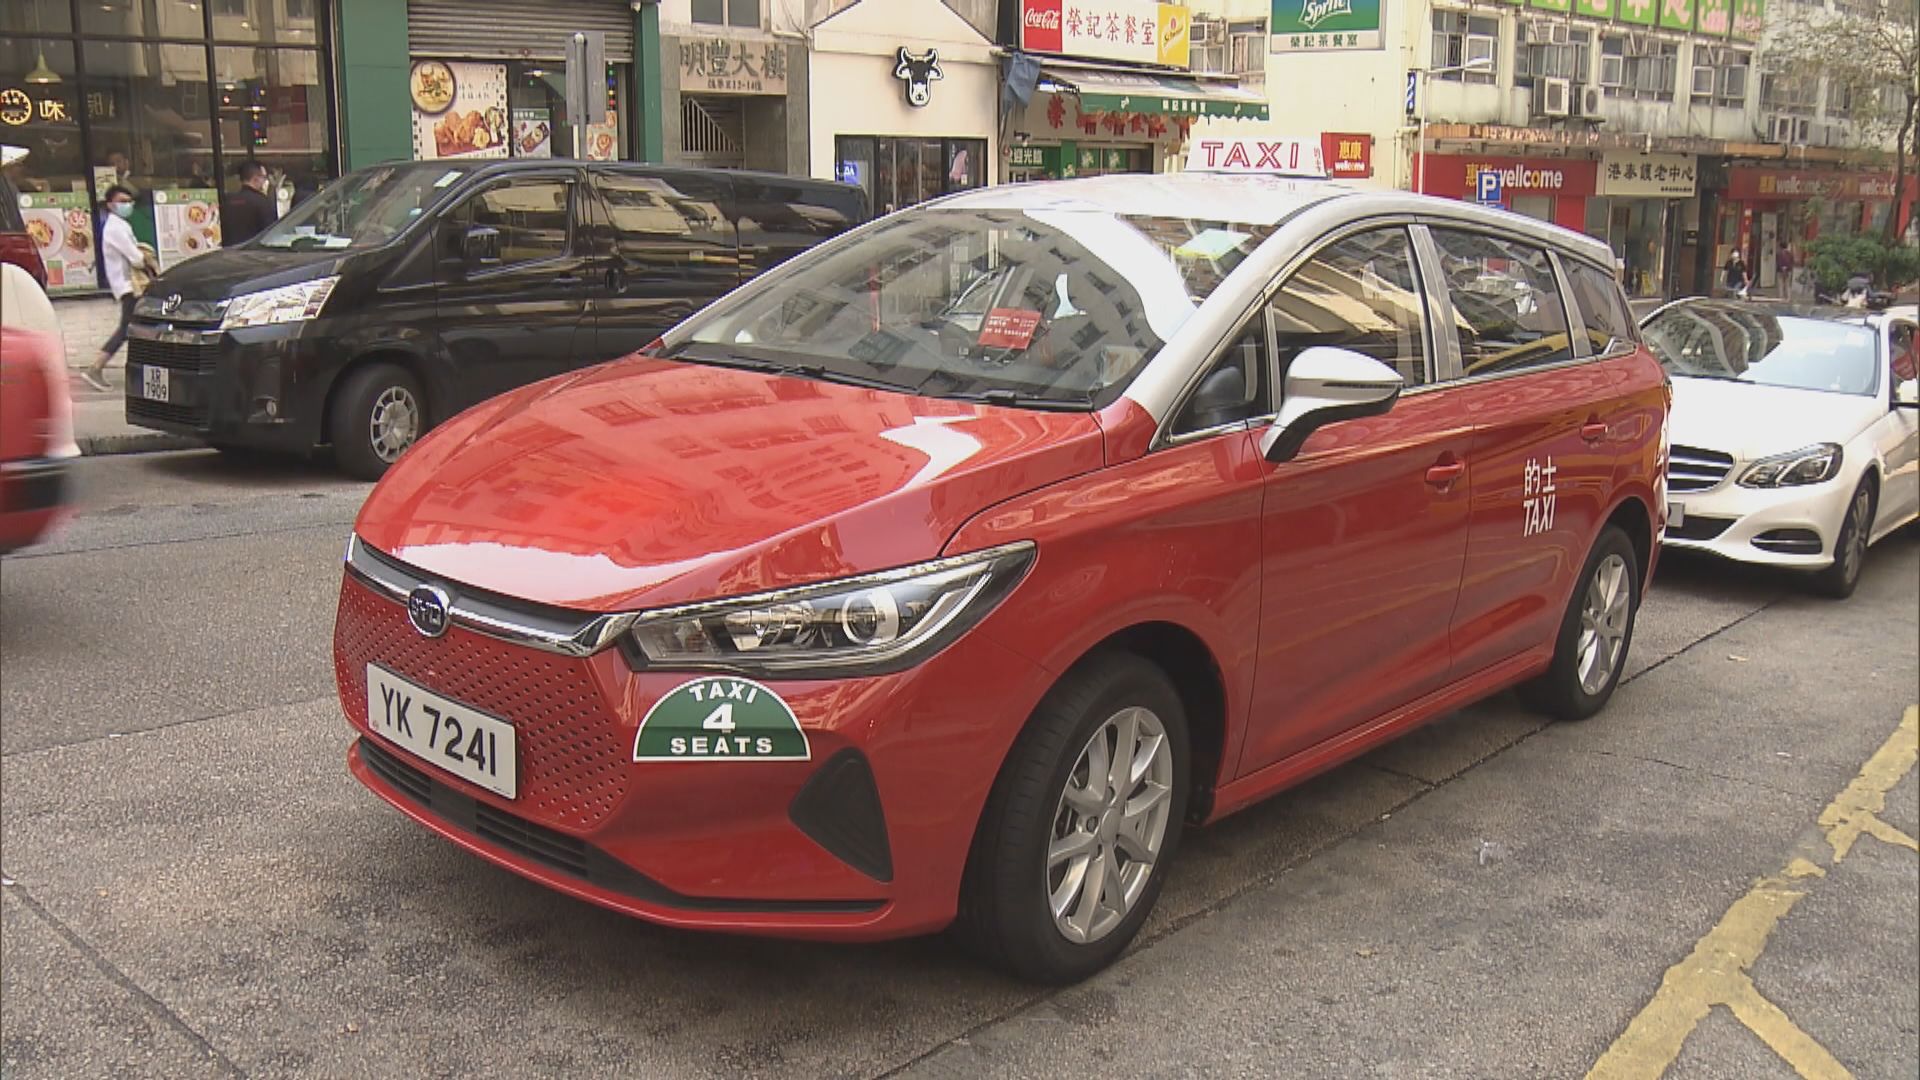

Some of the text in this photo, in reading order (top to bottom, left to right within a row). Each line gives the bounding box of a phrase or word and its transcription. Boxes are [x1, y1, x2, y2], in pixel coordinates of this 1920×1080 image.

[1066, 7, 1155, 46] 榮記茶餐室
[1201, 142, 1299, 169] TAXI
[1482, 175, 1497, 199] P
[146, 382, 167, 399] 7909
[1524, 456, 1557, 497] 的士
[1523, 494, 1556, 537] TAXI
[688, 681, 757, 704] TAXI
[380, 682, 497, 777] YK 7241
[702, 703, 735, 733] 4
[670, 737, 773, 755] SEATS
